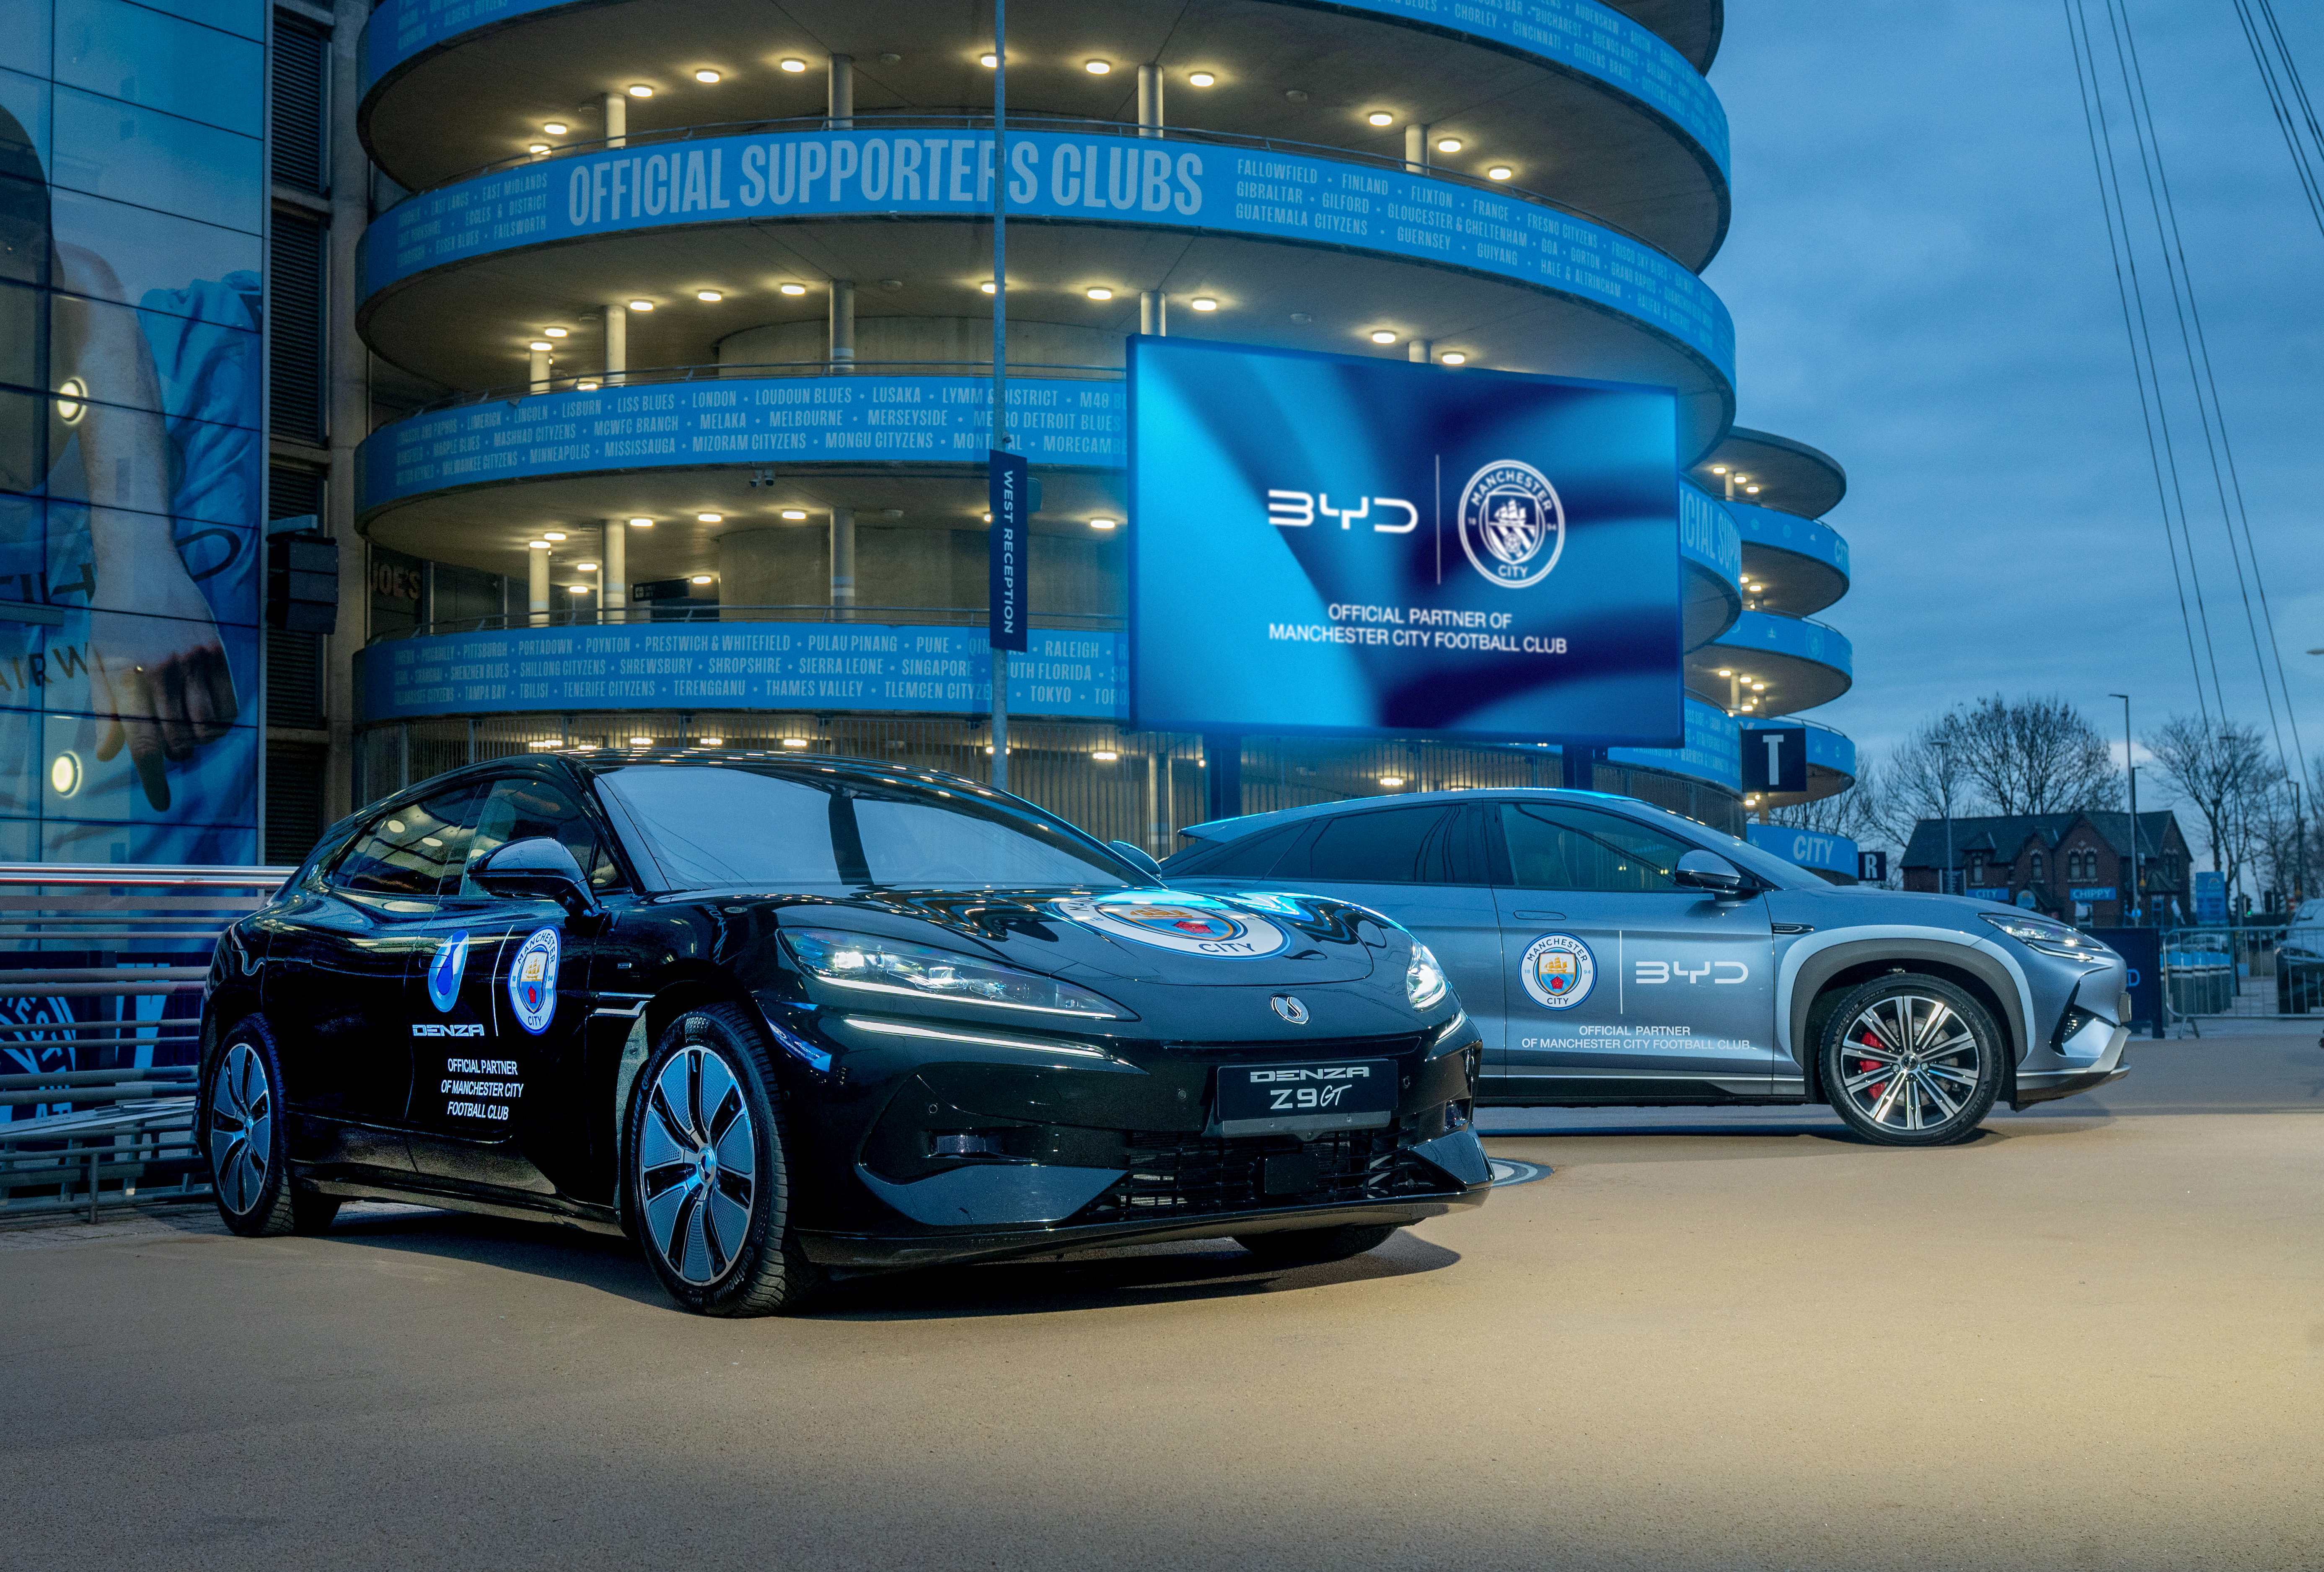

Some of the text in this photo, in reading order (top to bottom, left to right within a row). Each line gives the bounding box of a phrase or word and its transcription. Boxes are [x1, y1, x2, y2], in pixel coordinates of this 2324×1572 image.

[1455, 3, 1497, 29] CHORLEY
[1513, 20, 1561, 49] CINCINNATI
[1536, 8, 1581, 37] BUCHAREST
[482, 183, 501, 202] EAST
[504, 172, 547, 195] MIDLANDS
[569, 138, 1203, 226] OFFICIAL SUPPORTERS CLUBS
[509, 193, 546, 216] DISTRICT
[1237, 159, 1317, 184] FALLOWFIELD
[1342, 173, 1388, 195] FINLAND
[1411, 185, 1452, 208] FLIXTON
[1473, 199, 1508, 222] FRANCE
[1528, 213, 1559, 236] FRESNO
[1563, 223, 1597, 248] CITYZENS
[494, 215, 546, 240] FAILSWORTH
[1237, 181, 1303, 204] GIBRALTAR
[1322, 192, 1369, 214] GILFORD
[1388, 202, 1453, 230] GLOUCESTER
[1456, 216, 1462, 232] &
[1465, 218, 1527, 248] CHELTENHAM
[1542, 238, 1558, 256] GOA
[1571, 247, 1600, 270] GORTON
[1236, 203, 1307, 226] GUATEMALA
[1315, 213, 1367, 235] CITYZENS
[1398, 226, 1451, 251] GUERNSEY
[1478, 243, 1517, 266] GUIYANG
[1541, 259, 1561, 278] HALE
[1566, 266, 1570, 281] &
[1575, 269, 1620, 298] ALTRINCHAM
[514, 405, 548, 424] LINCOLN
[562, 400, 601, 419] LISBURN
[618, 396, 639, 413] LISS
[642, 393, 674, 411] BLUES
[693, 390, 736, 409] LONDON
[756, 388, 810, 406] LOUDOUN
[814, 387, 852, 404] BLUES
[872, 387, 921, 403] LUSAKA
[942, 387, 983, 404] LYMM
[1080, 392, 1109, 409] M40
[494, 429, 533, 447] MASHHAD
[536, 424, 576, 442] CITYZENS
[594, 417, 632, 437] MCWFC
[636, 416, 678, 434] BRANCH
[700, 413, 746, 429] MELAKA
[769, 410, 843, 427] MELBOURNE
[867, 410, 948, 426] MERSEYSIDE
[1023, 412, 1076, 429] DETROIT
[1081, 414, 1121, 432] BLUES
[483, 451, 518, 470] CITYZENS
[530, 444, 590, 464] MINNEAPOLIS
[604, 437, 675, 458] MISSISSAUGA
[693, 434, 748, 452] MIZORAM
[752, 433, 806, 450] CITYZENS
[826, 432, 872, 448] MONGU
[875, 432, 933, 449] CITYZENS
[1471, 470, 1553, 511] MANCHESTER
[1268, 489, 1418, 534] BYD
[1680, 489, 1716, 560] ICIAL
[1004, 471, 1013, 633] WEST RECEPTION
[1498, 565, 1528, 577] CITY
[1328, 603, 1511, 628] OFFICIAL PARTNER OF
[463, 635, 1099, 659] PITTSBURGH PORTADOWN POYNTON PRESTWICH & WHITEFIELD PULAU PINANG PUNE RALEIGH
[1269, 624, 1567, 654] MANCHESTER CITY FOOTBALL CLUB
[486, 662, 509, 679] BLUES
[520, 660, 560, 677] SHILLONG
[563, 659, 606, 676] CITYZENS
[620, 658, 693, 675] SHREWSBURY
[709, 657, 781, 674] SHROPSHIRE
[799, 658, 843, 674] SIERRA
[846, 658, 884, 675] LEONE
[902, 659, 973, 677] SINGAPORE
[1038, 663, 1092, 681] FLORIDA
[465, 680, 1071, 703] TAMPA BAY TBILISI TENERIFE CITYZENS TERENGGANU THAMES VALLEY TLEMCEN TOKYO
[1763, 734, 1784, 786] T
[1793, 835, 1834, 864] CITY
[1864, 853, 1878, 879] R
[1976, 889, 2110, 899] CITY CHIPPY
[518, 932, 555, 964] MANCHESTER
[1198, 943, 1256, 952] CITY
[1527, 938, 1587, 962] MANCHESTER
[1636, 961, 1749, 984] BYD
[412, 1024, 485, 1037] DENZA
[528, 1016, 542, 1026] CITY
[1579, 1026, 1690, 1037] OFFICIAL PARTNER
[1521, 1038, 1750, 1050] OF MANCHESTER CITY FOOTBALL CLUB
[448, 1058, 518, 1076] OFFICIAL PARTNER
[1250, 1066, 1369, 1083] DENZA
[441, 1079, 524, 1097] OF MANCHESTER CITY
[447, 1101, 509, 1120] FOOTBALL CLUB
